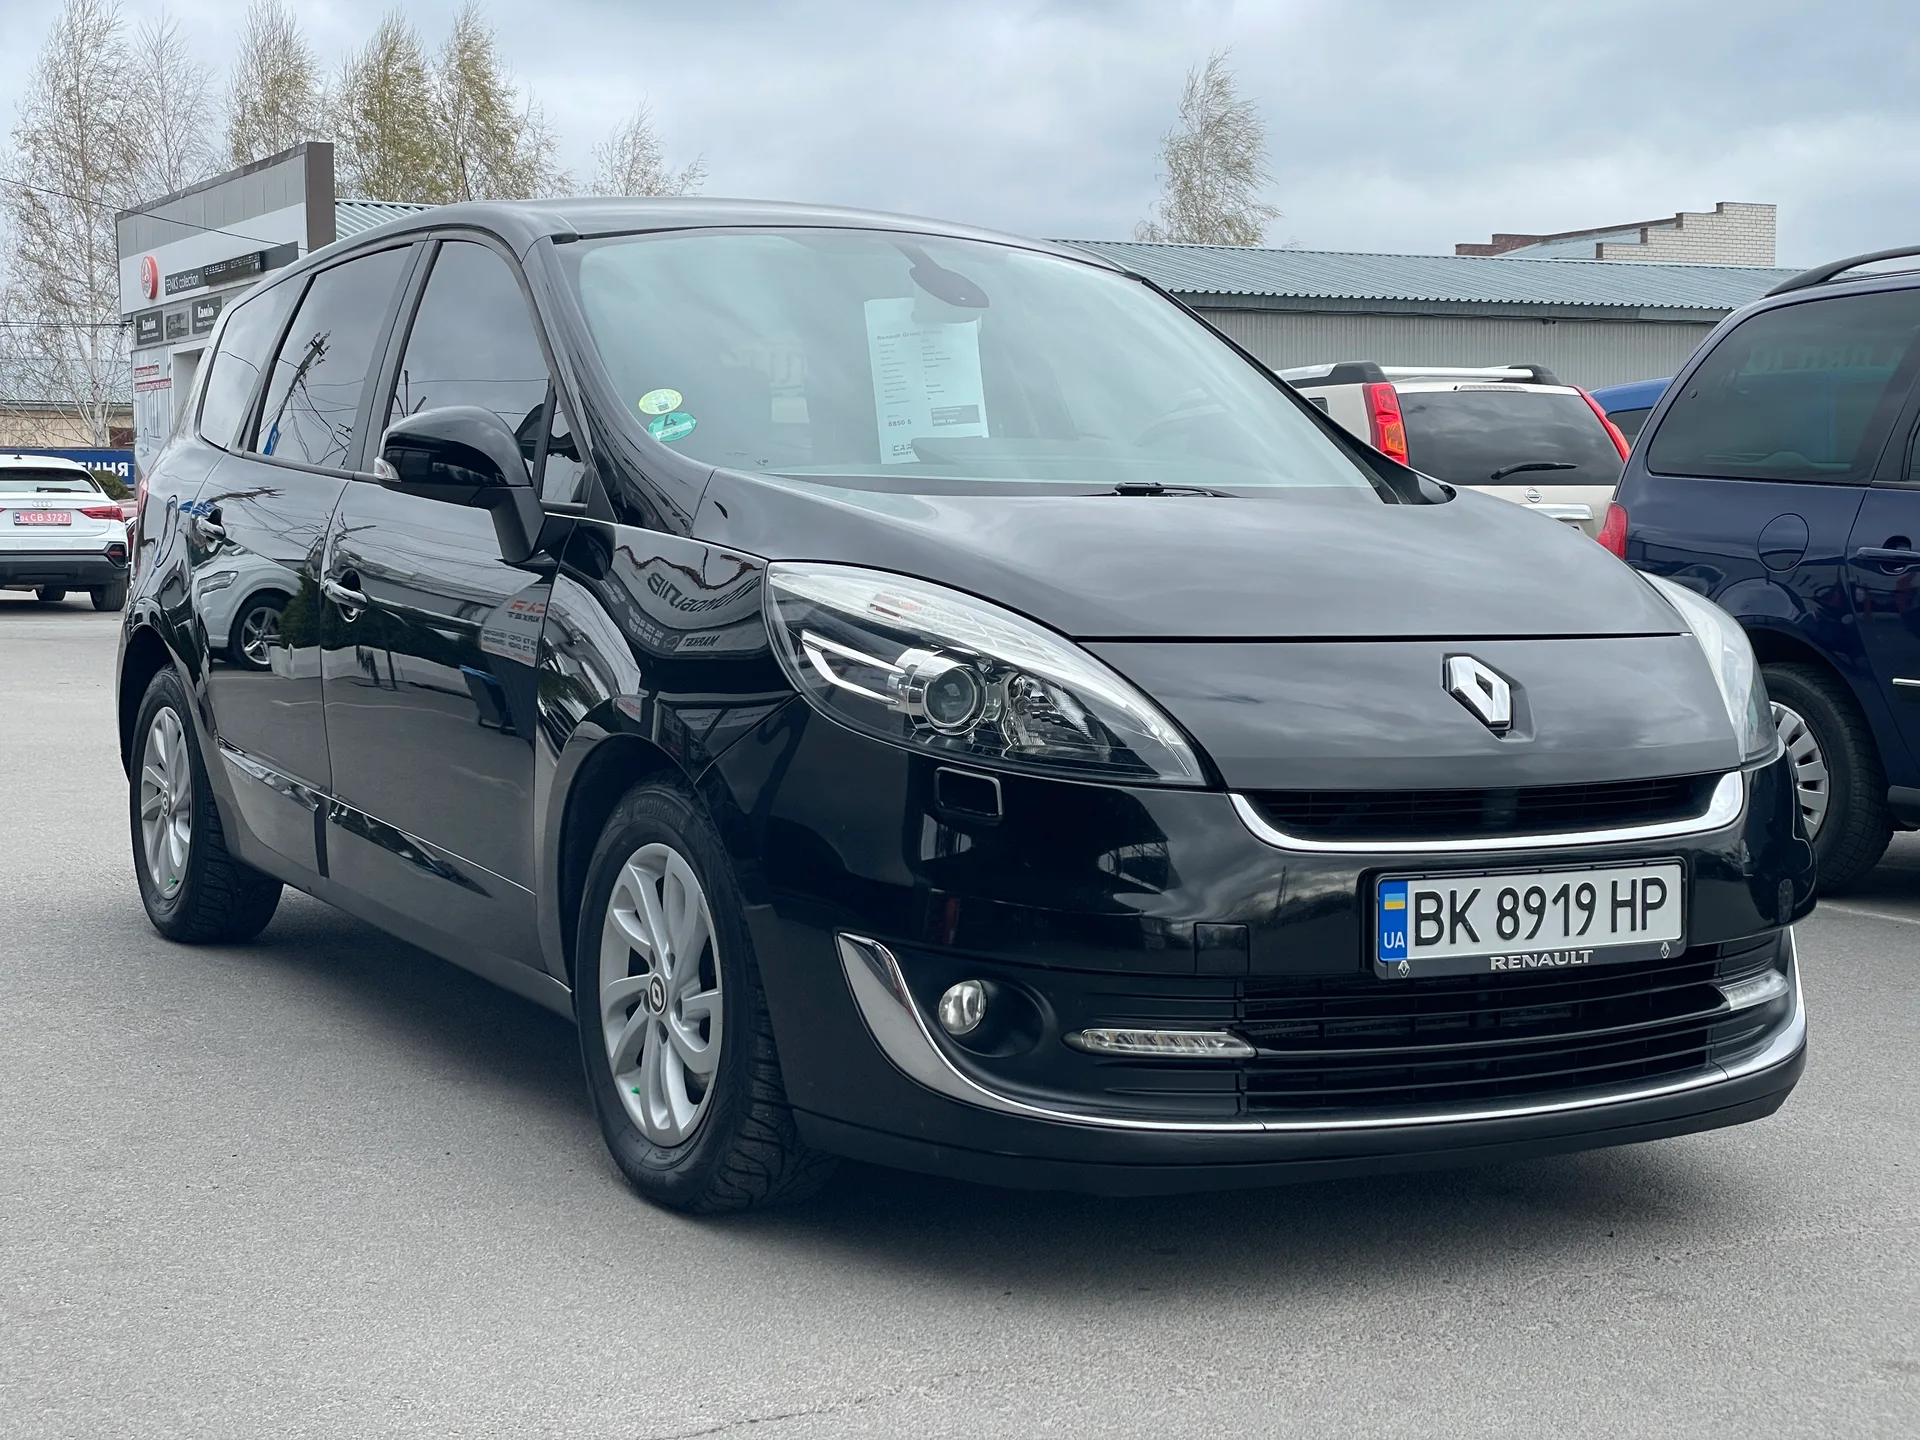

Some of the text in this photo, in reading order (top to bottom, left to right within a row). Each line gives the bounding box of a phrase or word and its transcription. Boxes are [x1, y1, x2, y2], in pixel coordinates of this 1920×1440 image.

[78, 461, 129, 477] ННЯ
[47, 513, 68, 522] 3727
[1383, 875, 1669, 949] UA BK 8919 HP
[1489, 949, 1594, 971] RENAULT
